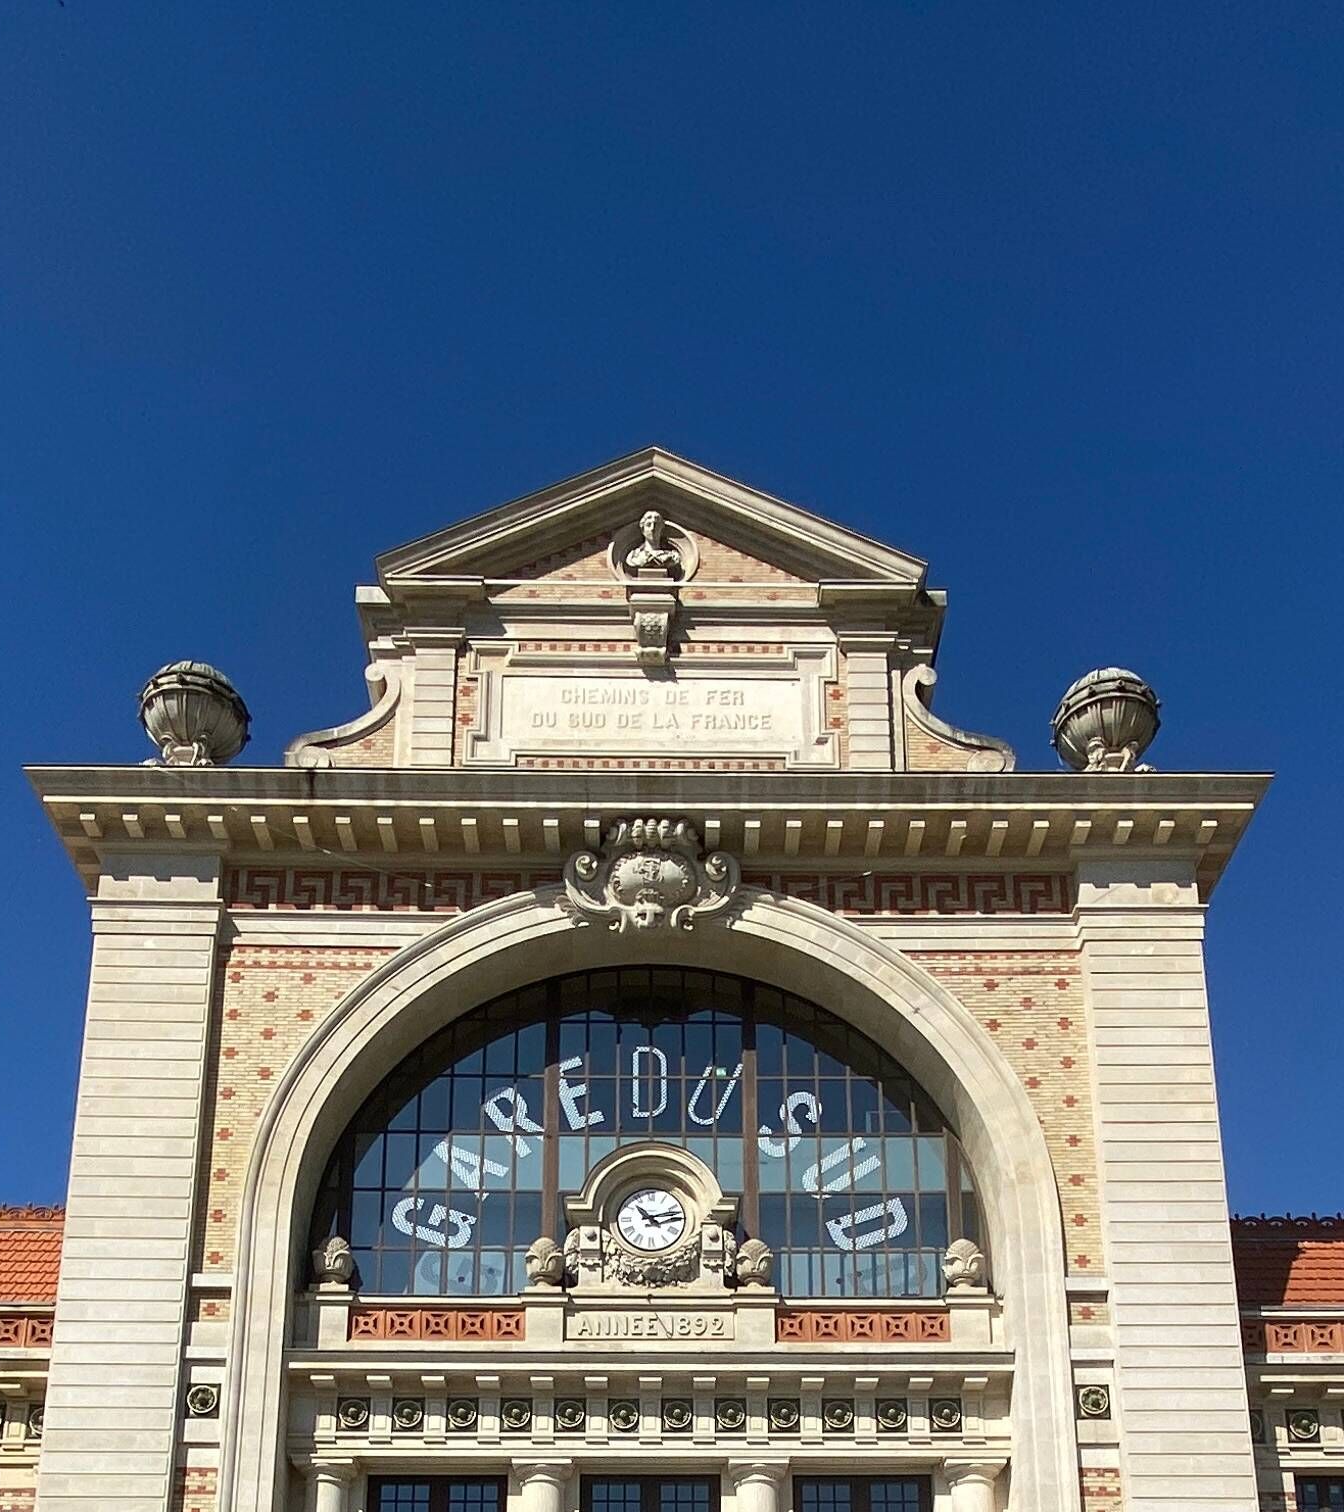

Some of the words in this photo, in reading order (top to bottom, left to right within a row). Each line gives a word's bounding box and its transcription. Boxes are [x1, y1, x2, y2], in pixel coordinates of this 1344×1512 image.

[560, 687, 650, 706] CHEMINS
[665, 689, 690, 706] DE
[705, 689, 746, 707] FER
[530, 711, 558, 729] DU
[567, 711, 607, 730] SUD
[616, 712, 644, 730] DE
[651, 712, 681, 730] LA
[690, 713, 773, 731] FRANCE
[391, 1056, 605, 1249] GARE
[632, 1046, 744, 1126] DU
[757, 1090, 908, 1251] SUD
[577, 1315, 659, 1337] ANNEE
[668, 1316, 725, 1337] 1892
